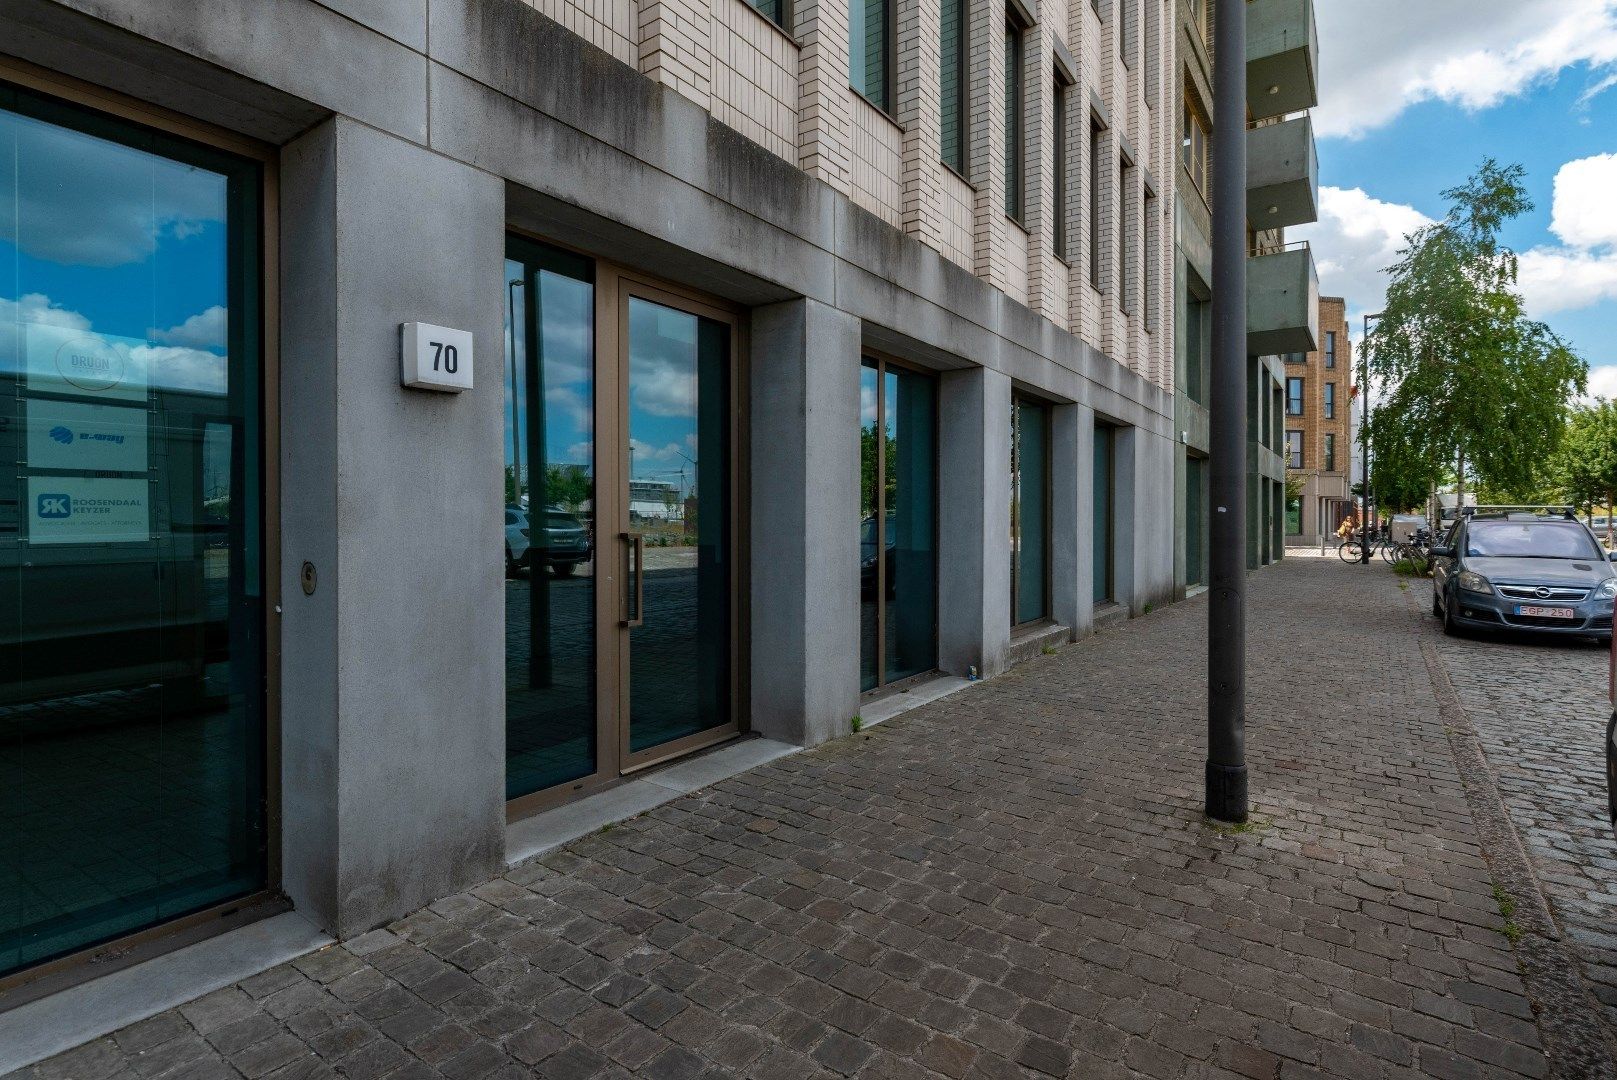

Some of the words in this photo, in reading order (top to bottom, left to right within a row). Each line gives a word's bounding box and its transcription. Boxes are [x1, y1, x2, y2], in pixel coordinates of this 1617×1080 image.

[71, 354, 110, 370] DRUON
[429, 341, 458, 374] 70
[72, 499, 142, 507] ROOSENDAAL
[72, 507, 112, 515] KEYZER
[1521, 606, 1544, 616] EGP
[1551, 608, 1572, 617] 250
